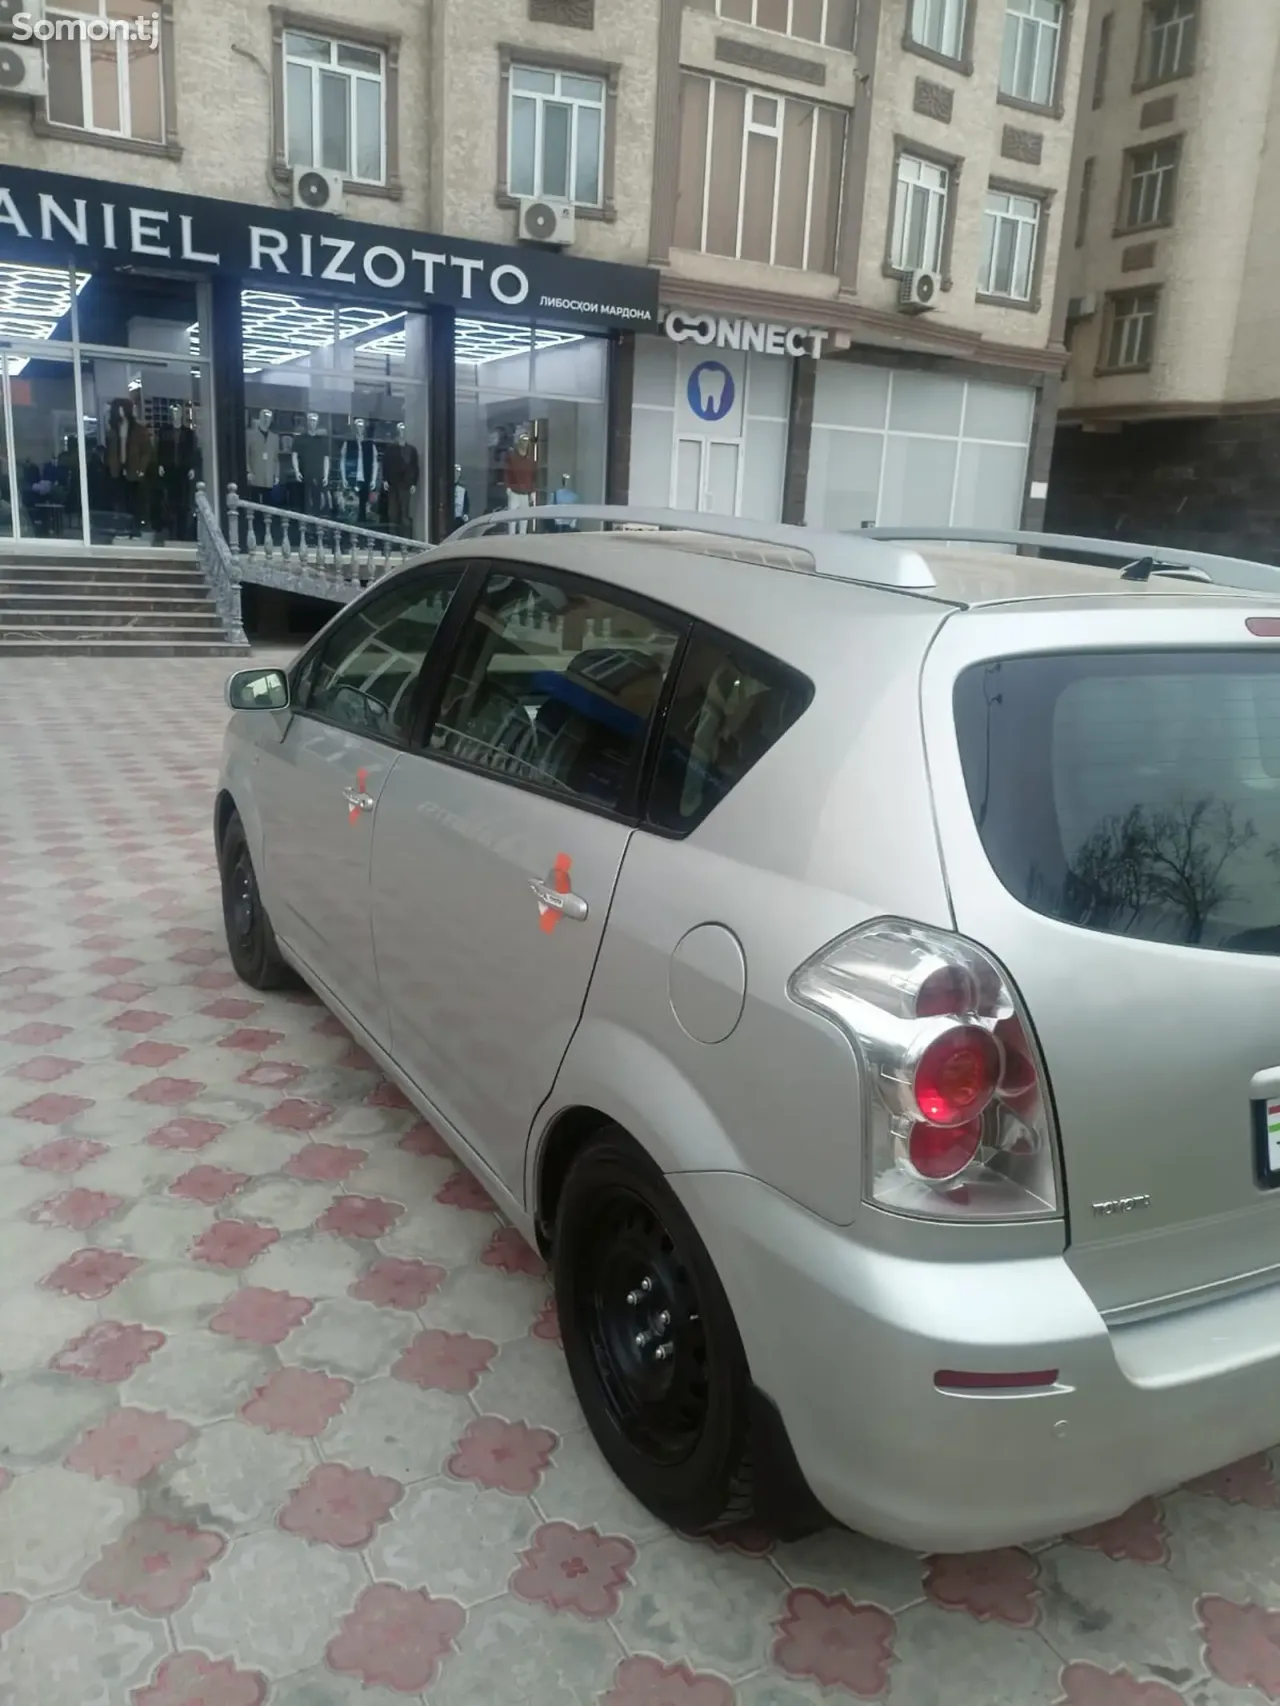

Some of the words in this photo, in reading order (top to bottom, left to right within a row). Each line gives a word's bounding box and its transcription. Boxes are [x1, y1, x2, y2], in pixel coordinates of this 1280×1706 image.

[248, 225, 529, 305] RIZOTTO
[600, 303, 652, 320] МАРДОНА
[665, 310, 829, 359] CONNECT
